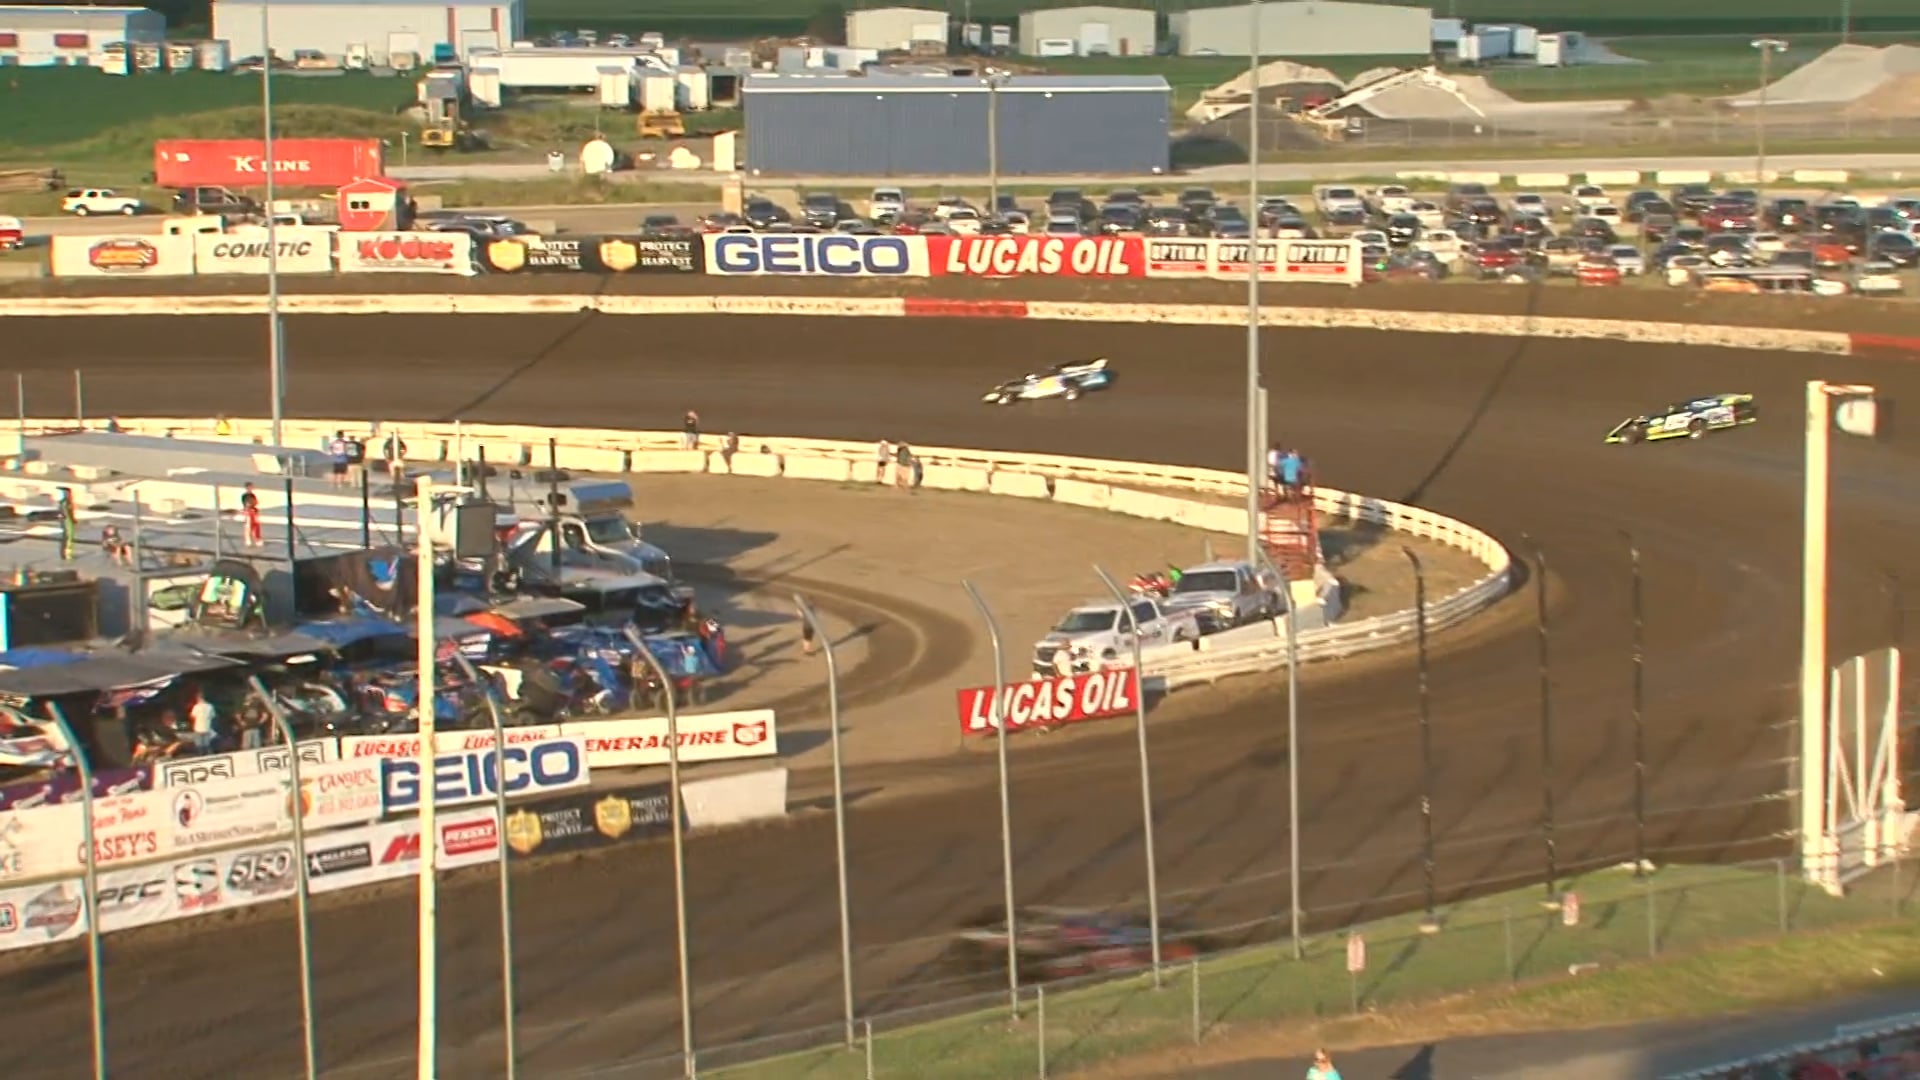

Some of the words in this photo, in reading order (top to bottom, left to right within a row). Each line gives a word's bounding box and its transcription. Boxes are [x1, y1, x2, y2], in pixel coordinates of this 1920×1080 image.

[233, 156, 254, 172] K
[528, 241, 579, 251] PROTECT
[639, 241, 691, 251] PROTECT
[714, 236, 910, 274] GEICO
[1150, 243, 1207, 262] OPTIMA
[1287, 244, 1348, 263] OPTIMA
[529, 256, 580, 266] HARVEST
[642, 256, 691, 266] HARVEST
[945, 238, 1064, 274] LUCAS
[1070, 240, 1130, 274] OIL
[970, 678, 1076, 729] LUCAS
[1081, 672, 1130, 715] OIL
[382, 741, 580, 809] GEICO
[77, 831, 157, 864] CASEY'S
[96, 879, 166, 903] PFC
